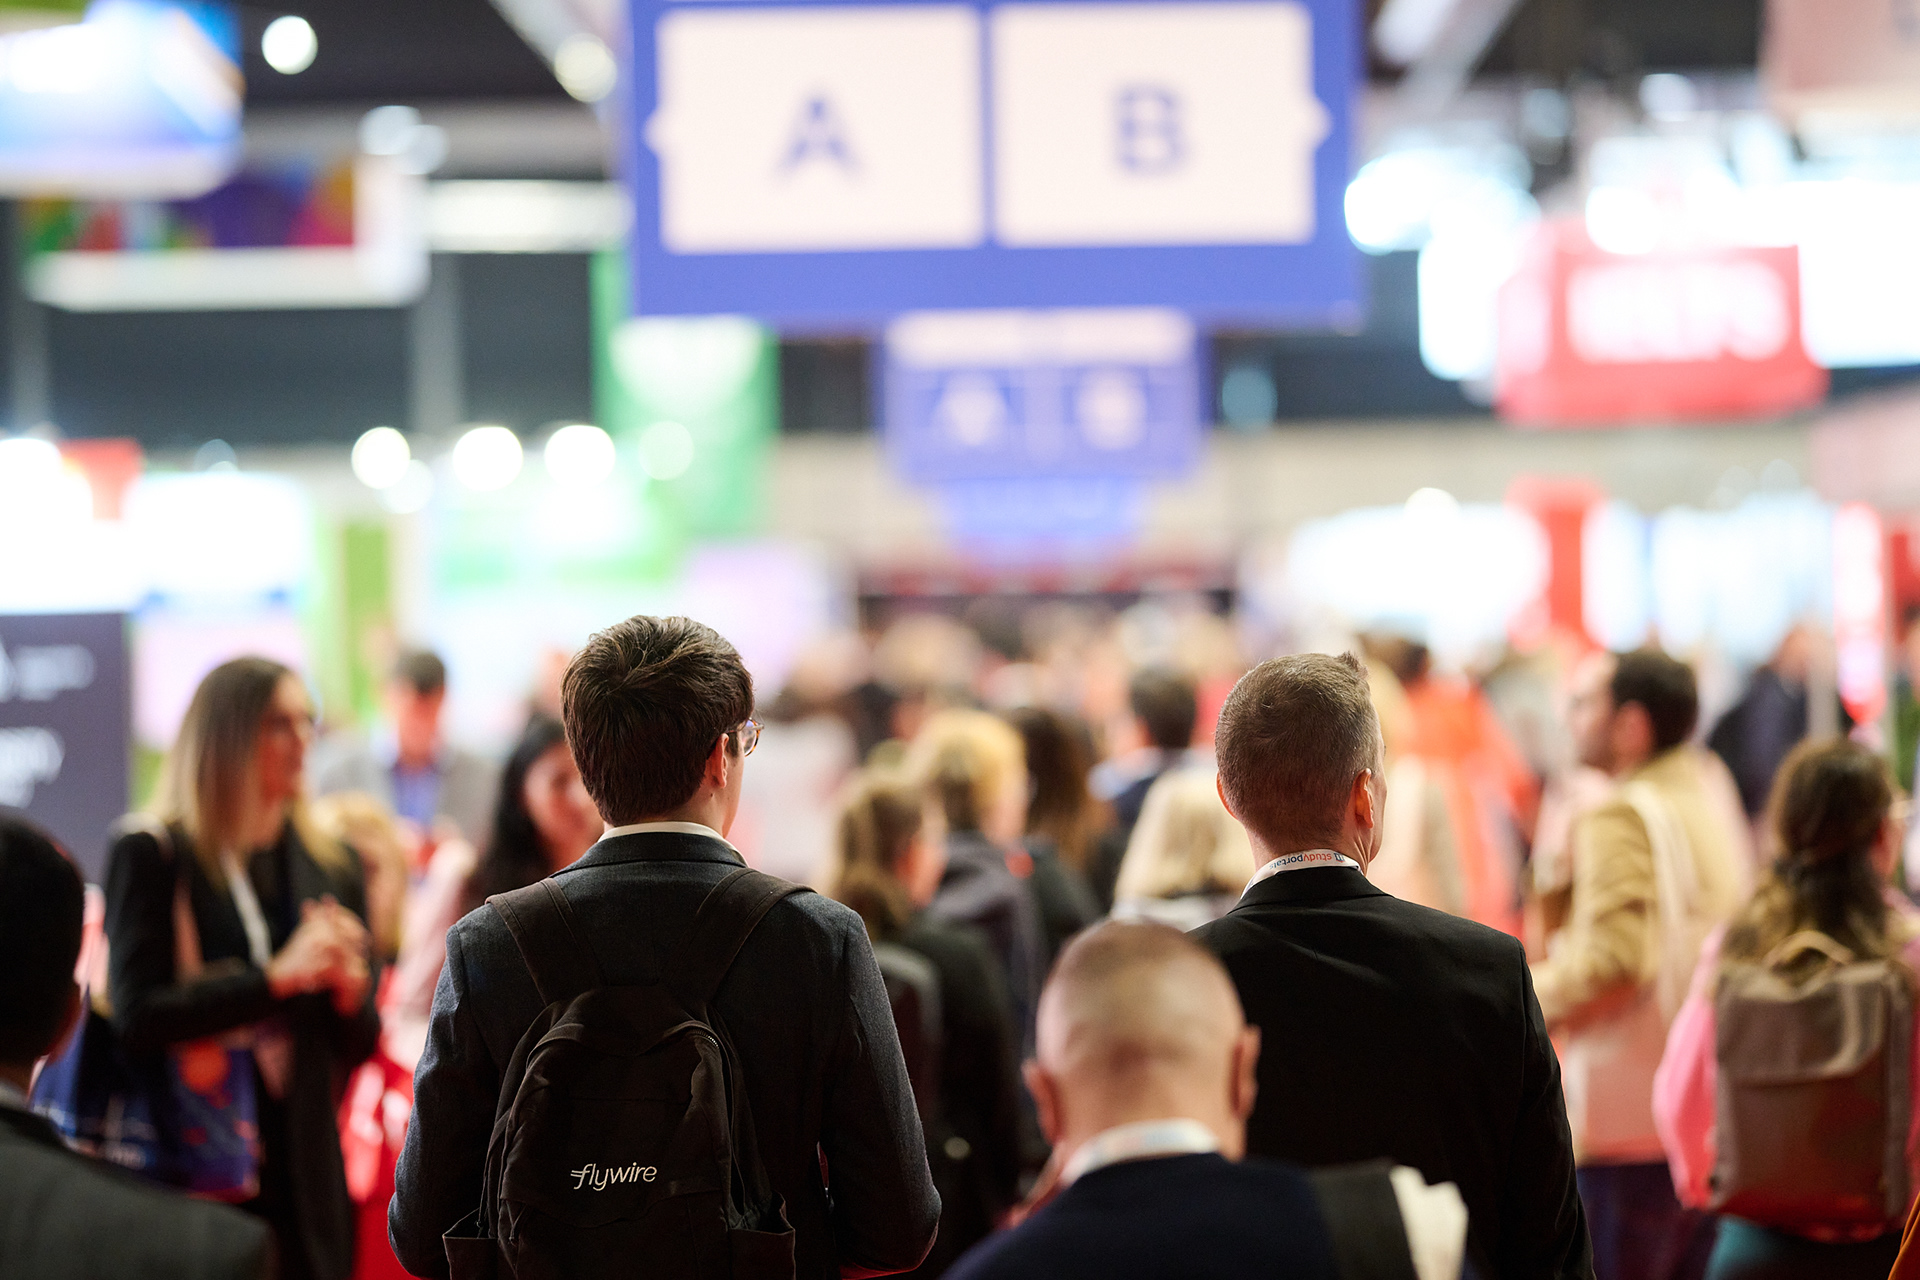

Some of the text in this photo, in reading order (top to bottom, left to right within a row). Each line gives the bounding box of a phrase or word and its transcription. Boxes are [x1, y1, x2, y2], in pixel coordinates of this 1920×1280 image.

[778, 82, 1188, 177] A B
[1269, 853, 1332, 869] studyportals
[570, 1162, 657, 1191] flywire
